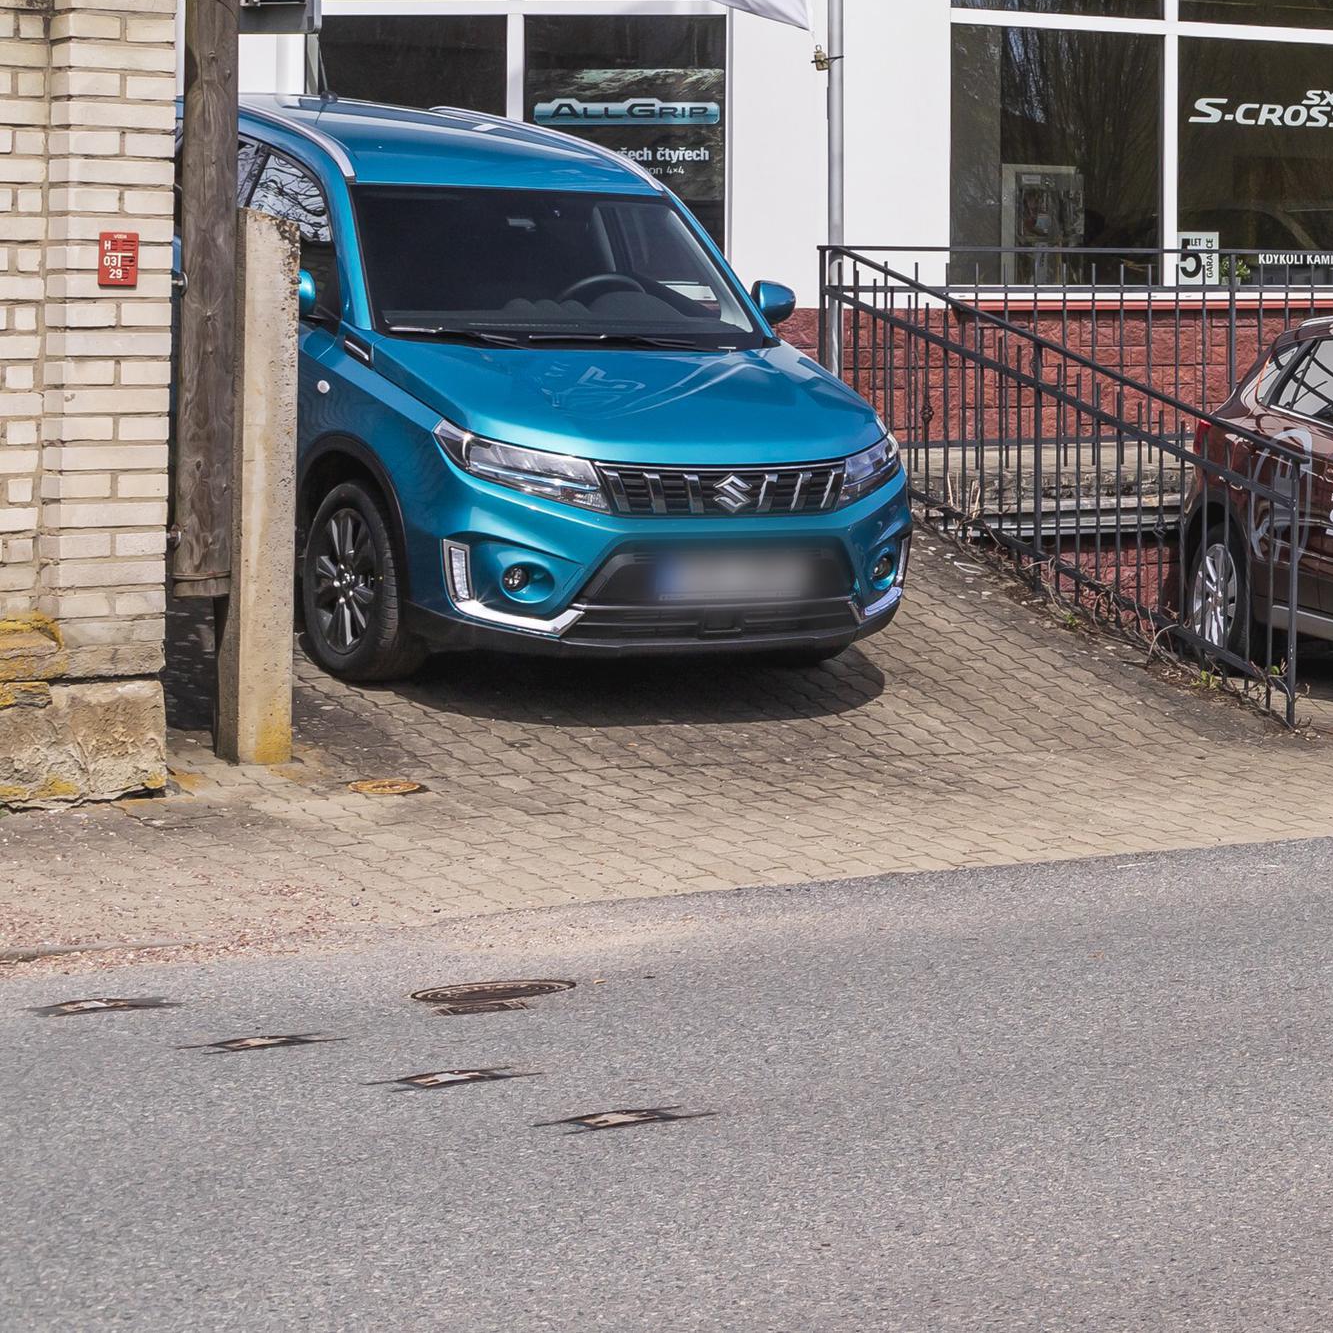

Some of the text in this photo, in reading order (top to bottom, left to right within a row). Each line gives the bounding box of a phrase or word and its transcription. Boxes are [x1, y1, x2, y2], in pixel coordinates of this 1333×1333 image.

[656, 146, 710, 163] čtyřech
[1180, 238, 1202, 278] 5 LET
[1258, 254, 1304, 265] KDYKOLI
[109, 269, 122, 279] 29
